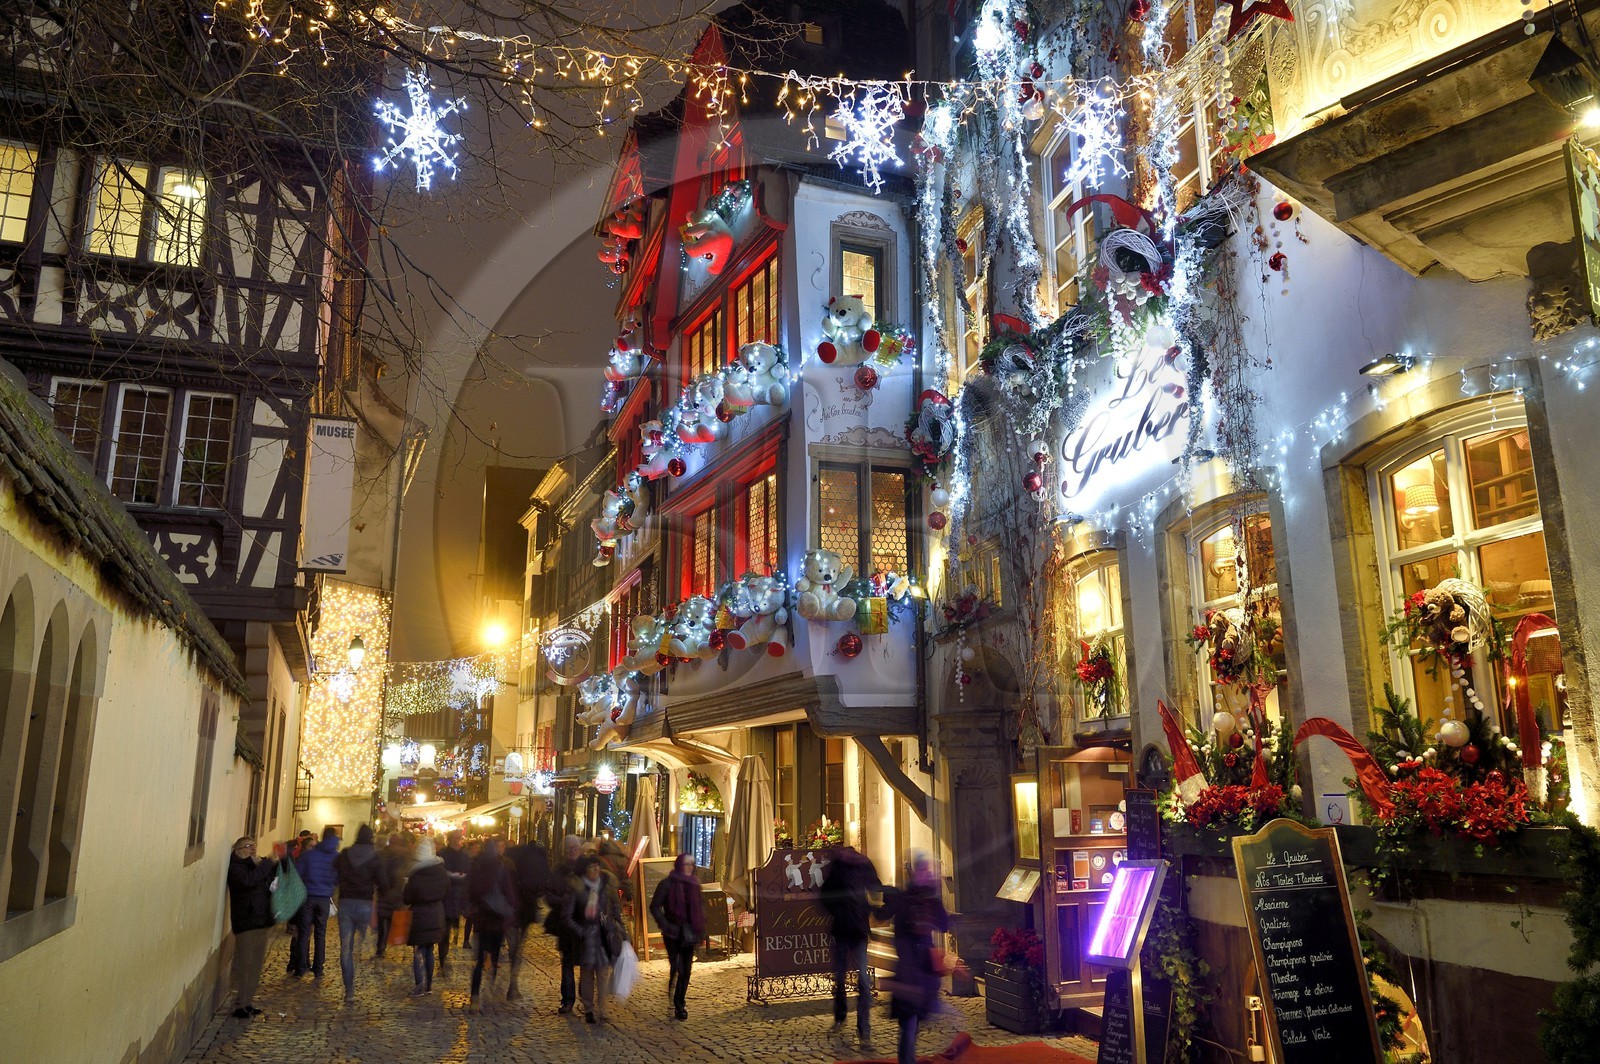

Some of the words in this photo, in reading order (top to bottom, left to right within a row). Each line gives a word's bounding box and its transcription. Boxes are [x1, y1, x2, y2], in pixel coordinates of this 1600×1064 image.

[316, 424, 355, 439] MUSEE
[1061, 386, 1190, 499] Gruber
[1266, 852, 1276, 865] Le
[1284, 850, 1309, 868] Gruber
[1255, 871, 1270, 888] Nos
[1273, 873, 1294, 886] Tartes
[1255, 897, 1290, 911] Alsacienne
[1260, 917, 1291, 934] Gratinée
[765, 932, 837, 952] RESTAURA
[1263, 937, 1303, 953] Champignons
[1267, 954, 1307, 969] Champignons
[1310, 950, 1334, 967] gratinée
[1271, 971, 1299, 984] Munster
[1273, 988, 1300, 1003] Fromage
[1304, 986, 1312, 996] de
[1314, 983, 1334, 996] chèvre
[1283, 1029, 1308, 1045] Salade
[1312, 1026, 1332, 1041] Verte
